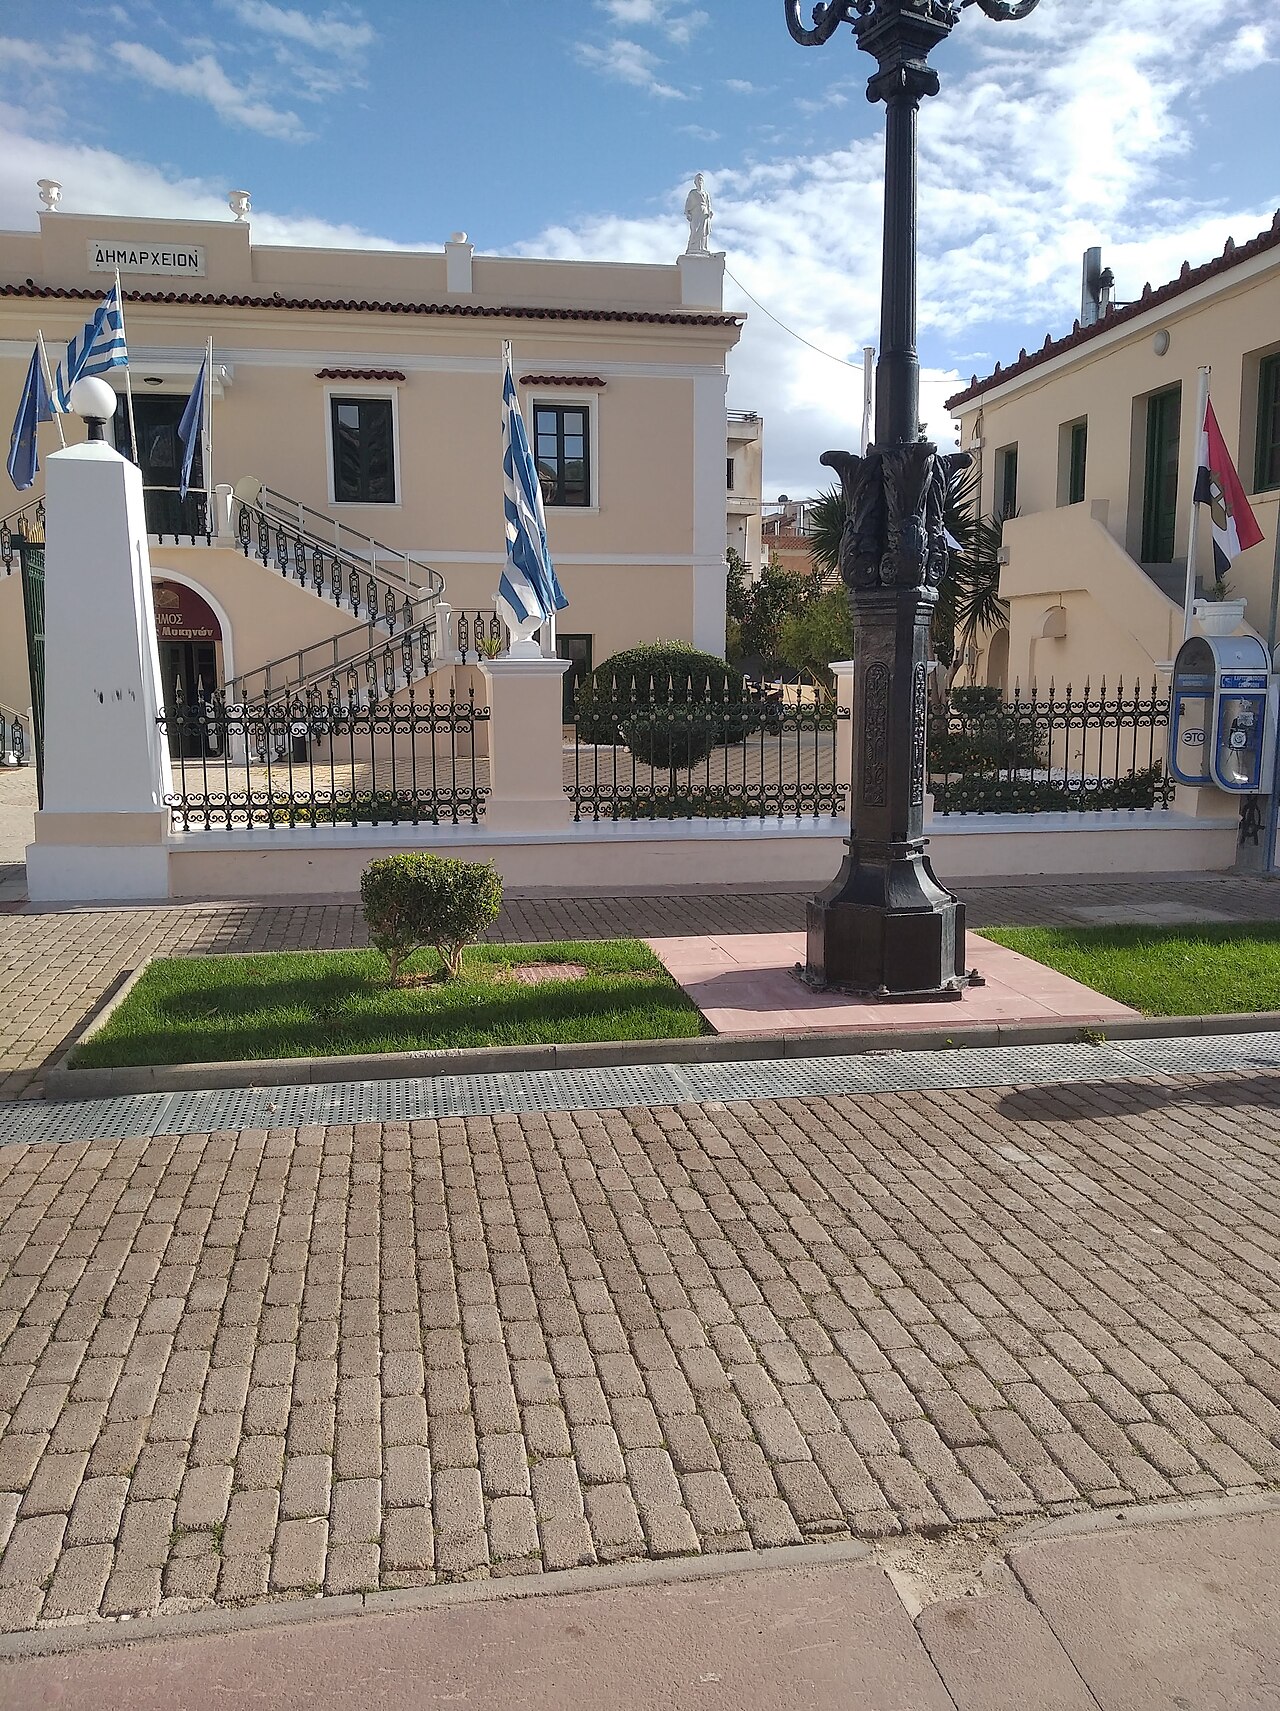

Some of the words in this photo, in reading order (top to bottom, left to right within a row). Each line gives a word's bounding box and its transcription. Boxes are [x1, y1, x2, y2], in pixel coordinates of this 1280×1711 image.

[95, 249, 198, 268] ΔΗΜΑΡΧΕΙΟΝ
[155, 613, 184, 625] ΗΜΟΣ
[161, 626, 214, 639] Μυκηνών
